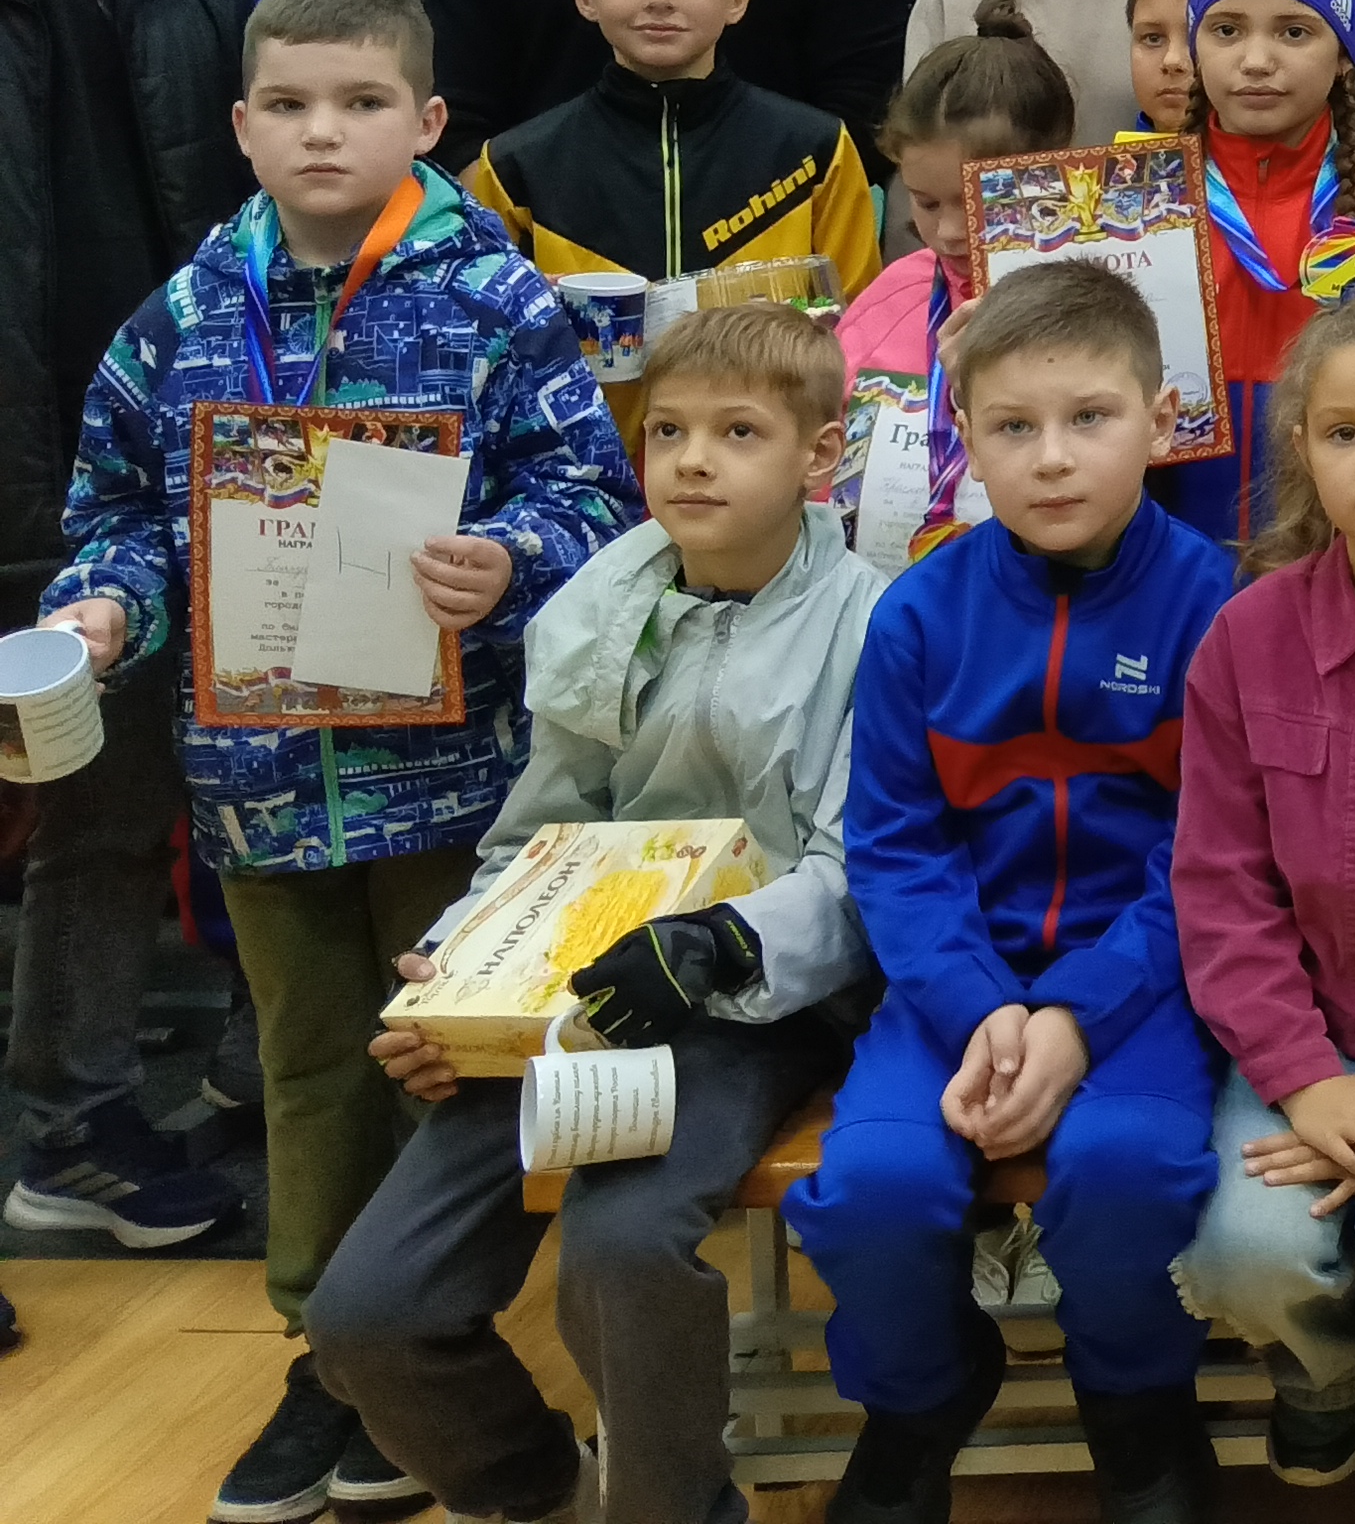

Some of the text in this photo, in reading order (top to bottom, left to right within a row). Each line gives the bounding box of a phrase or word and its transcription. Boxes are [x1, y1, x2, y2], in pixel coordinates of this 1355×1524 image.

[702, 154, 817, 252] Rohini
[258, 519, 317, 539] ГРА
[1100, 679, 1161, 695] NORDSKI
[478, 861, 581, 976] НАПОЛЕОН
